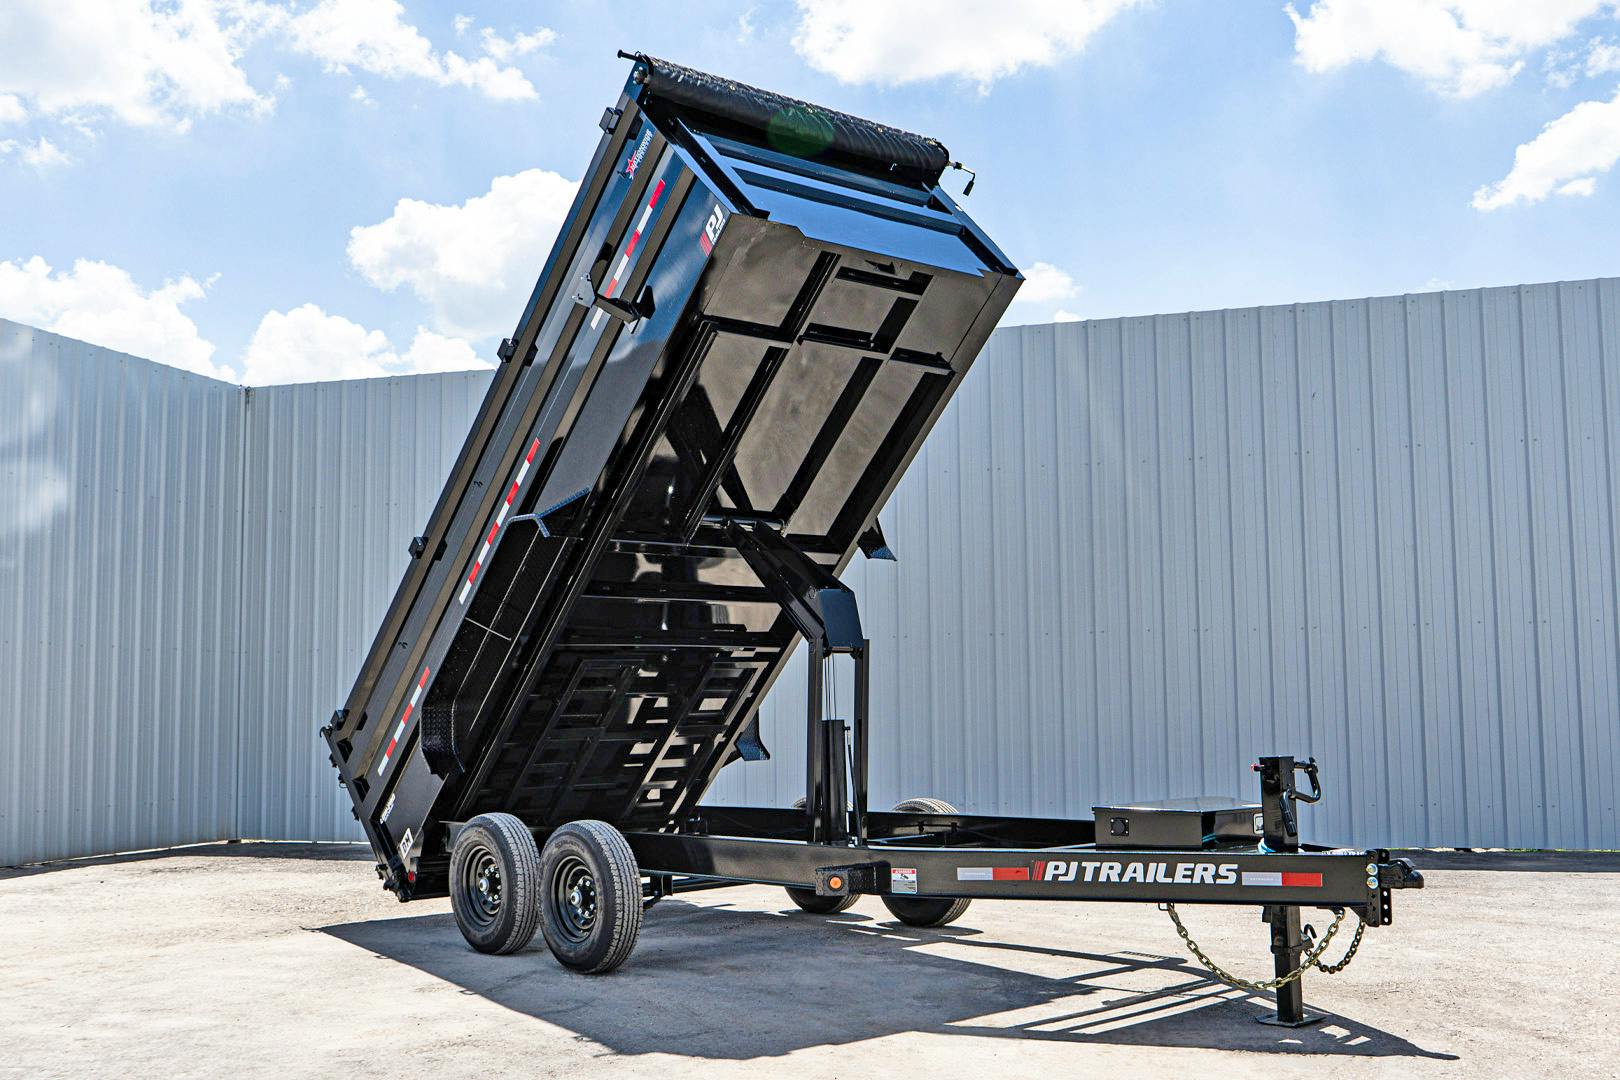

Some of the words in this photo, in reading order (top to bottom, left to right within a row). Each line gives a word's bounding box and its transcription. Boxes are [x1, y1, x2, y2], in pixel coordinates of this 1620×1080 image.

[705, 204, 723, 241] PJ
[1044, 861, 1078, 882] PJ
[1081, 862, 1238, 884] TRAILERS
